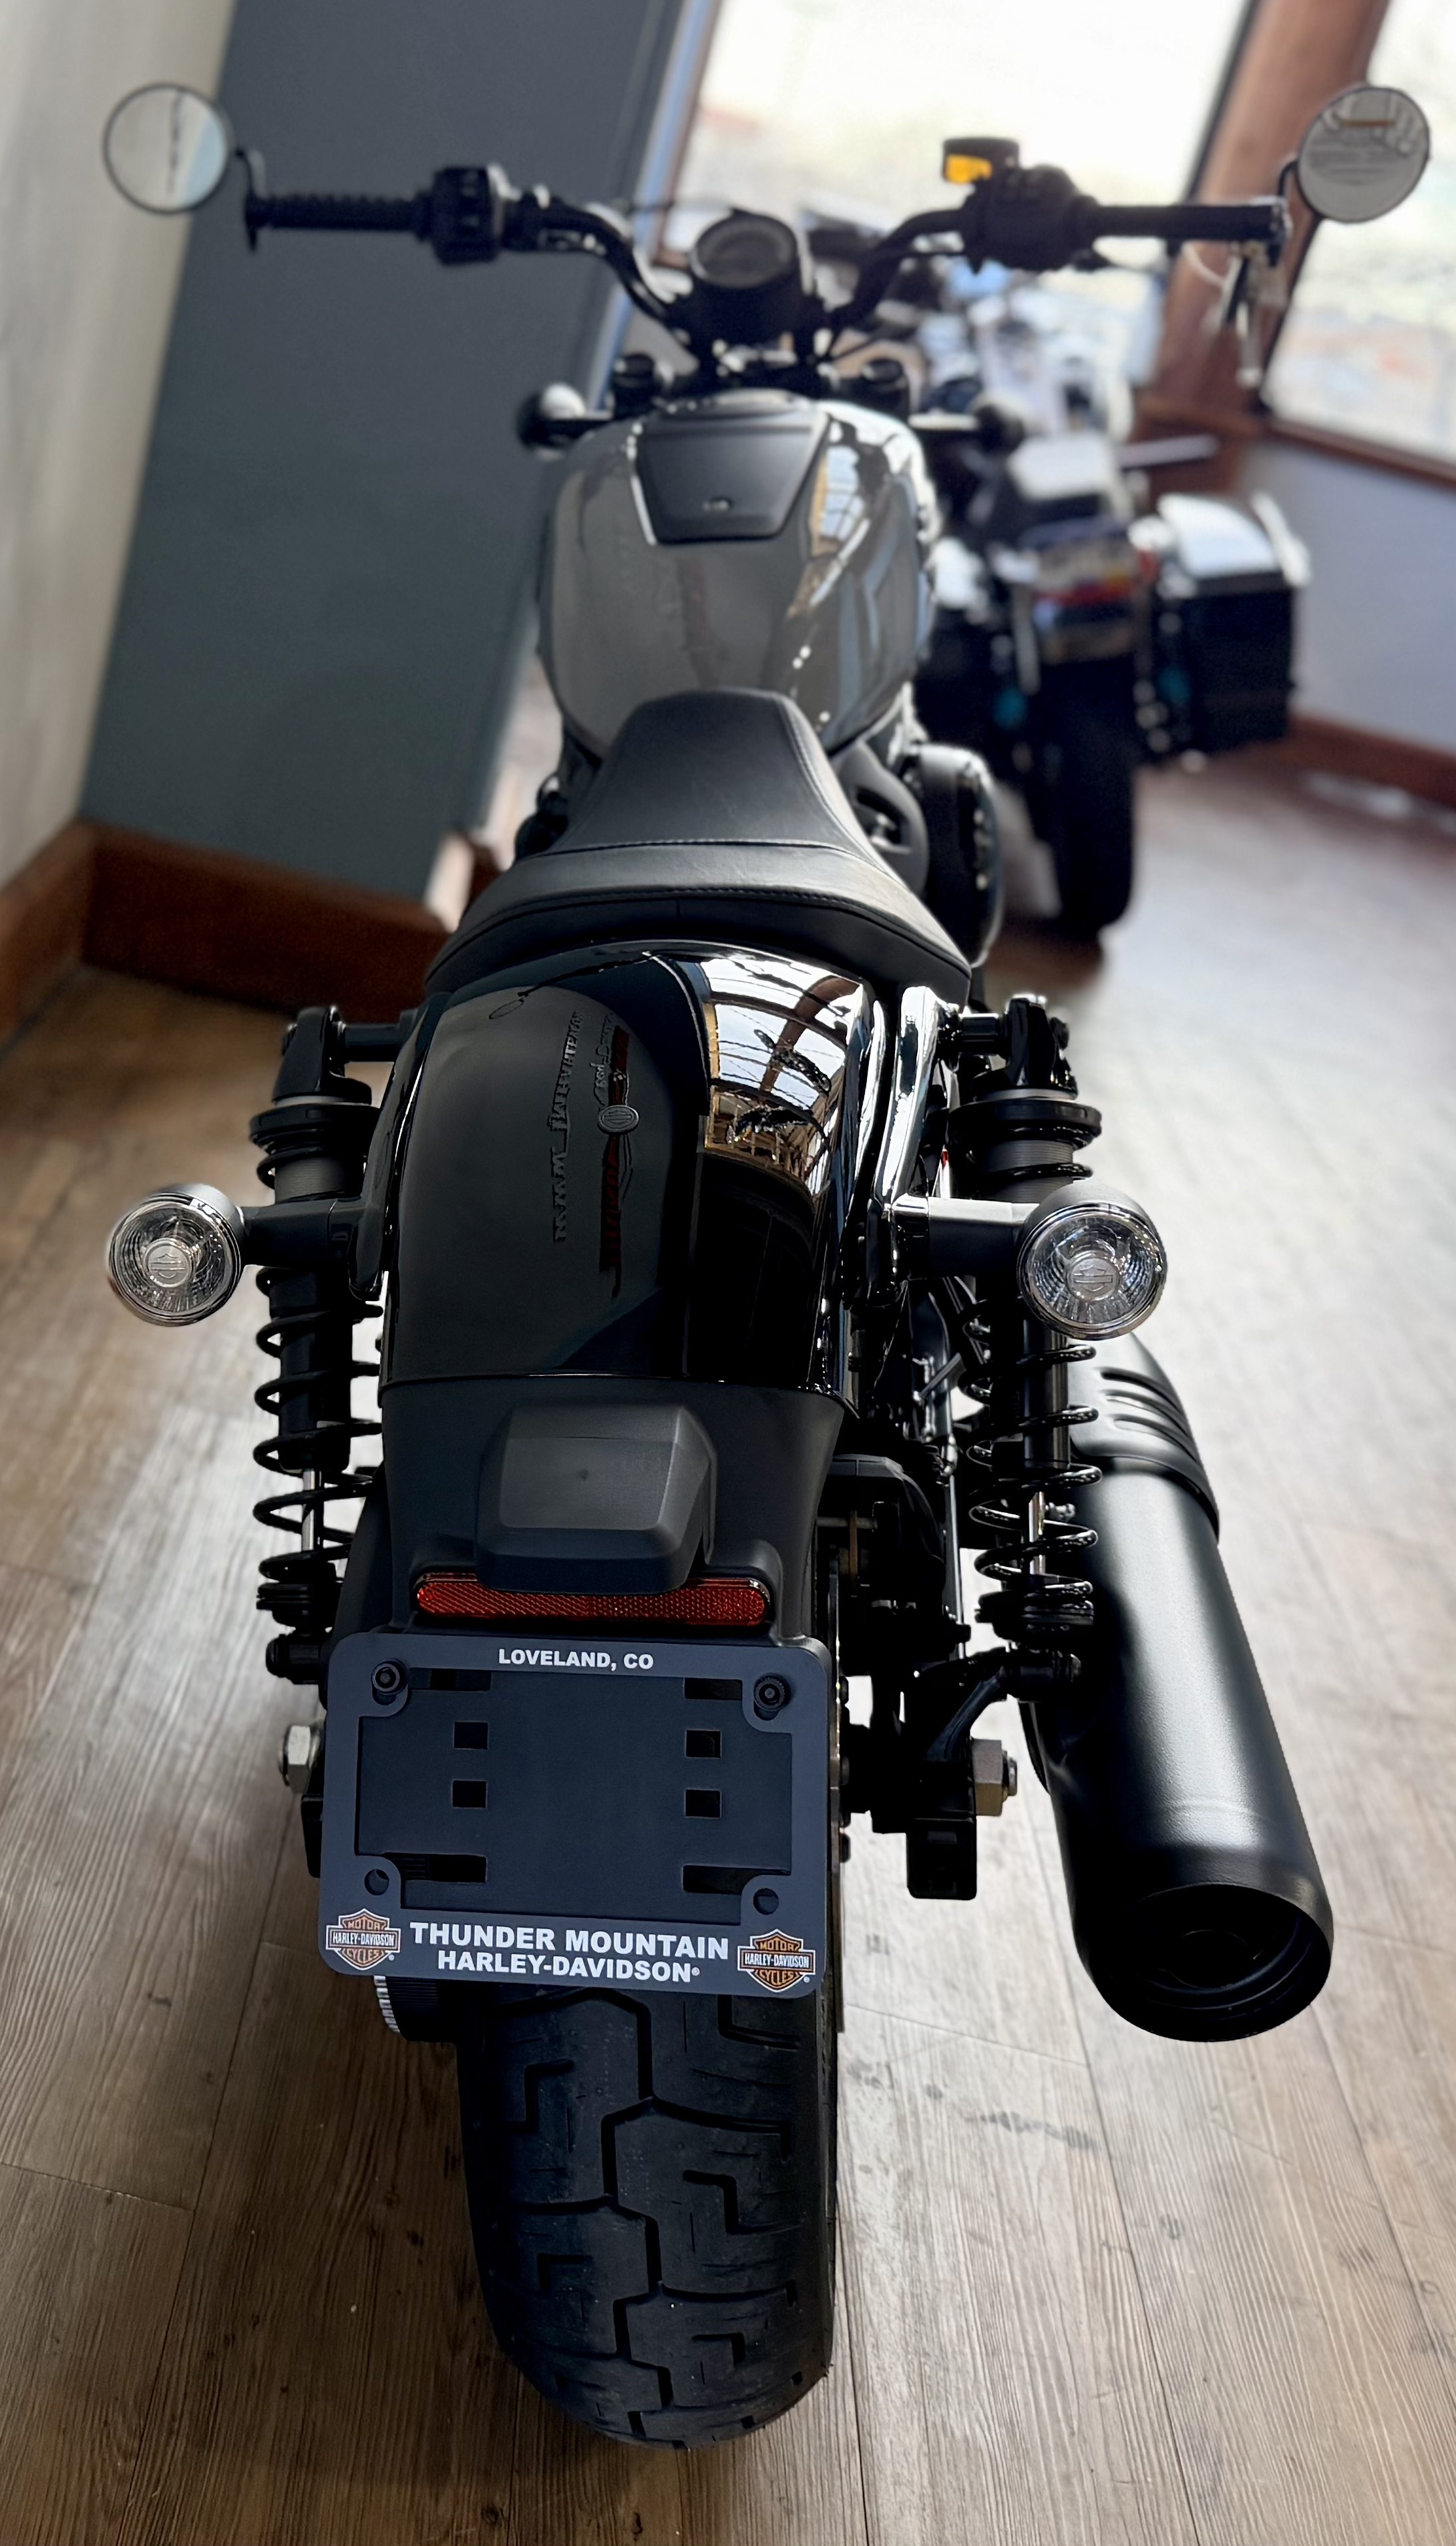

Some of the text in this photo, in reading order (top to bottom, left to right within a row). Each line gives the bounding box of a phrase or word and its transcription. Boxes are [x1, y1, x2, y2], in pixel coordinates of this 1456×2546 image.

[499, 1649, 654, 1671] LOVELAND, CO
[347, 1916, 380, 1930] MOTOR
[333, 1932, 395, 1947] HARLEY-DAVIDSON
[410, 1922, 728, 1959] THUNDER MOUNTAIN
[759, 1937, 795, 1952] MOTOR
[346, 1948, 379, 1964] CYCLES
[745, 1952, 809, 1968] HARLEY-DAVIDSON
[759, 1970, 793, 1986] CYCLES
